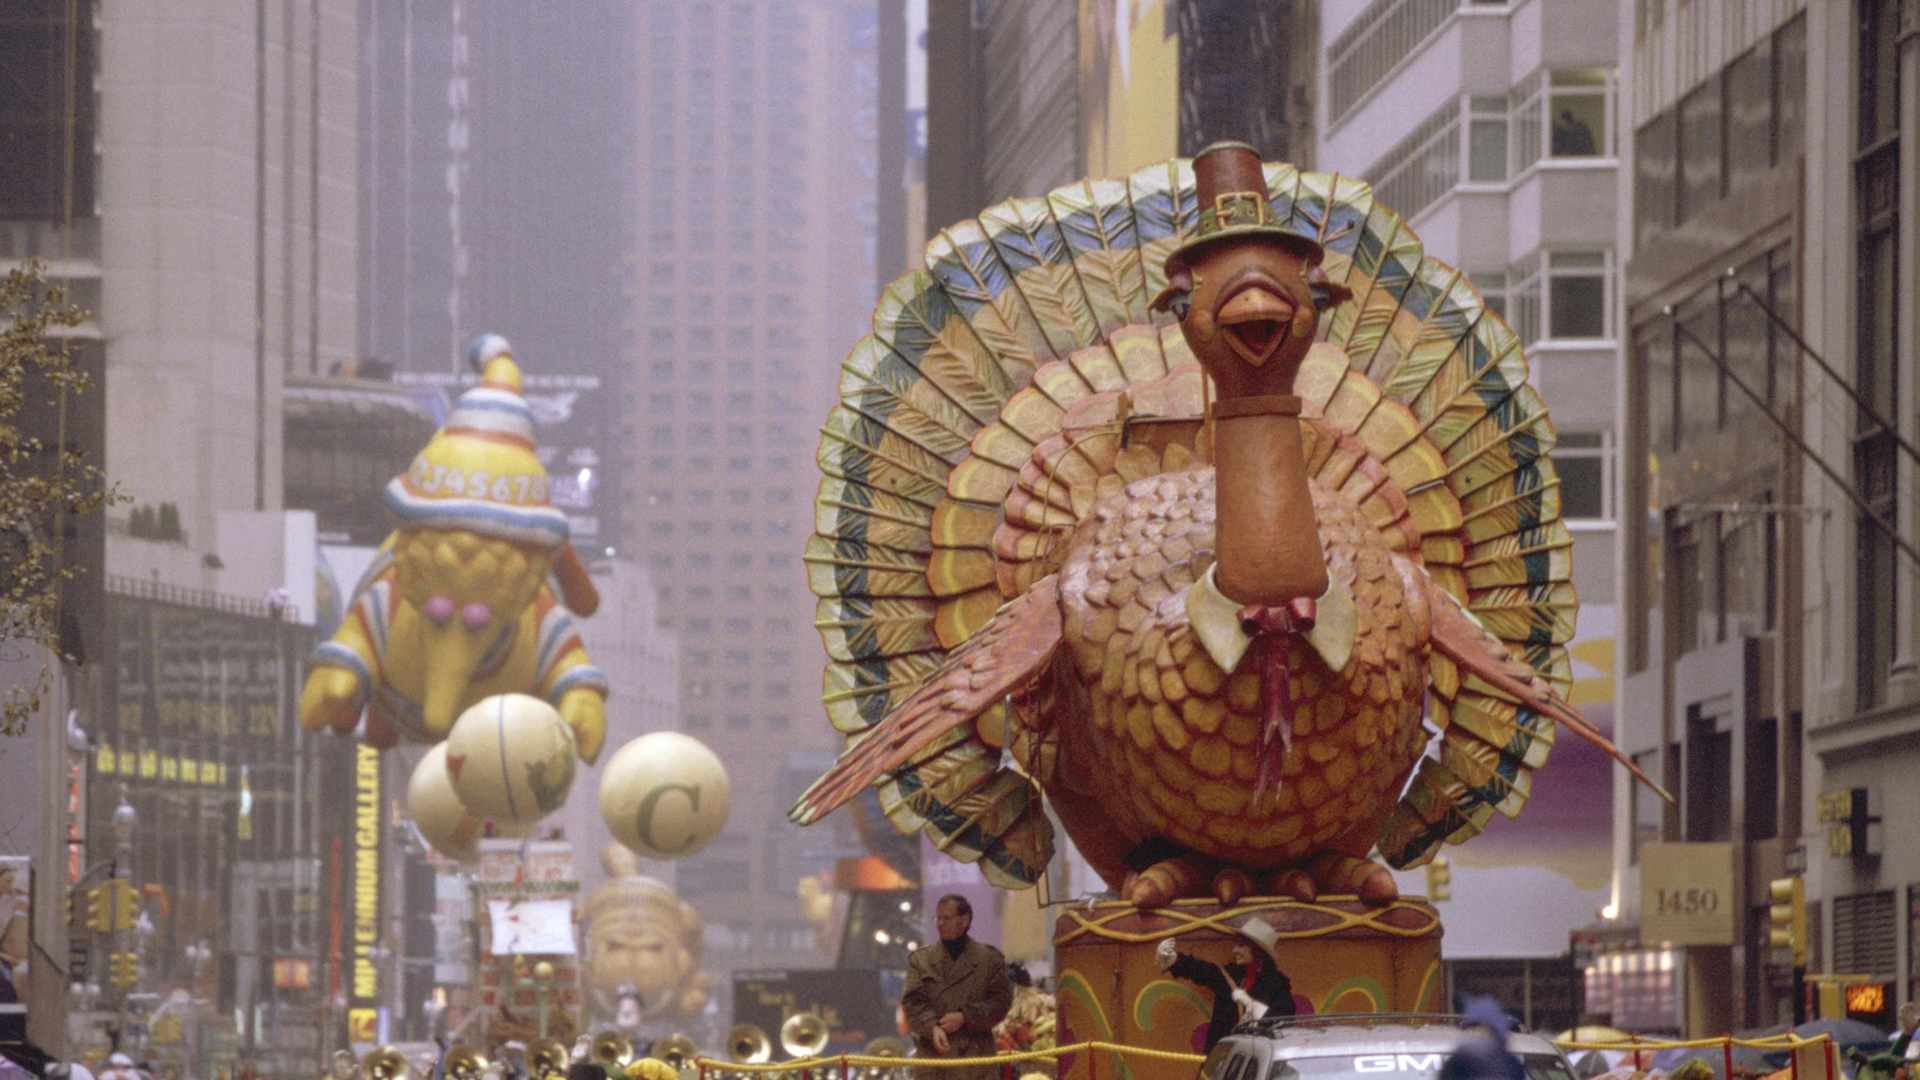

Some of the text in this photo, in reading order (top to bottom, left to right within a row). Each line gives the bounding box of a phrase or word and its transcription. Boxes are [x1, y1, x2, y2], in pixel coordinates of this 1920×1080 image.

[355, 744, 379, 847] GALLERY
[638, 784, 700, 853] C
[1656, 888, 1718, 912] 1450
[1354, 1054, 1446, 1072] GM
